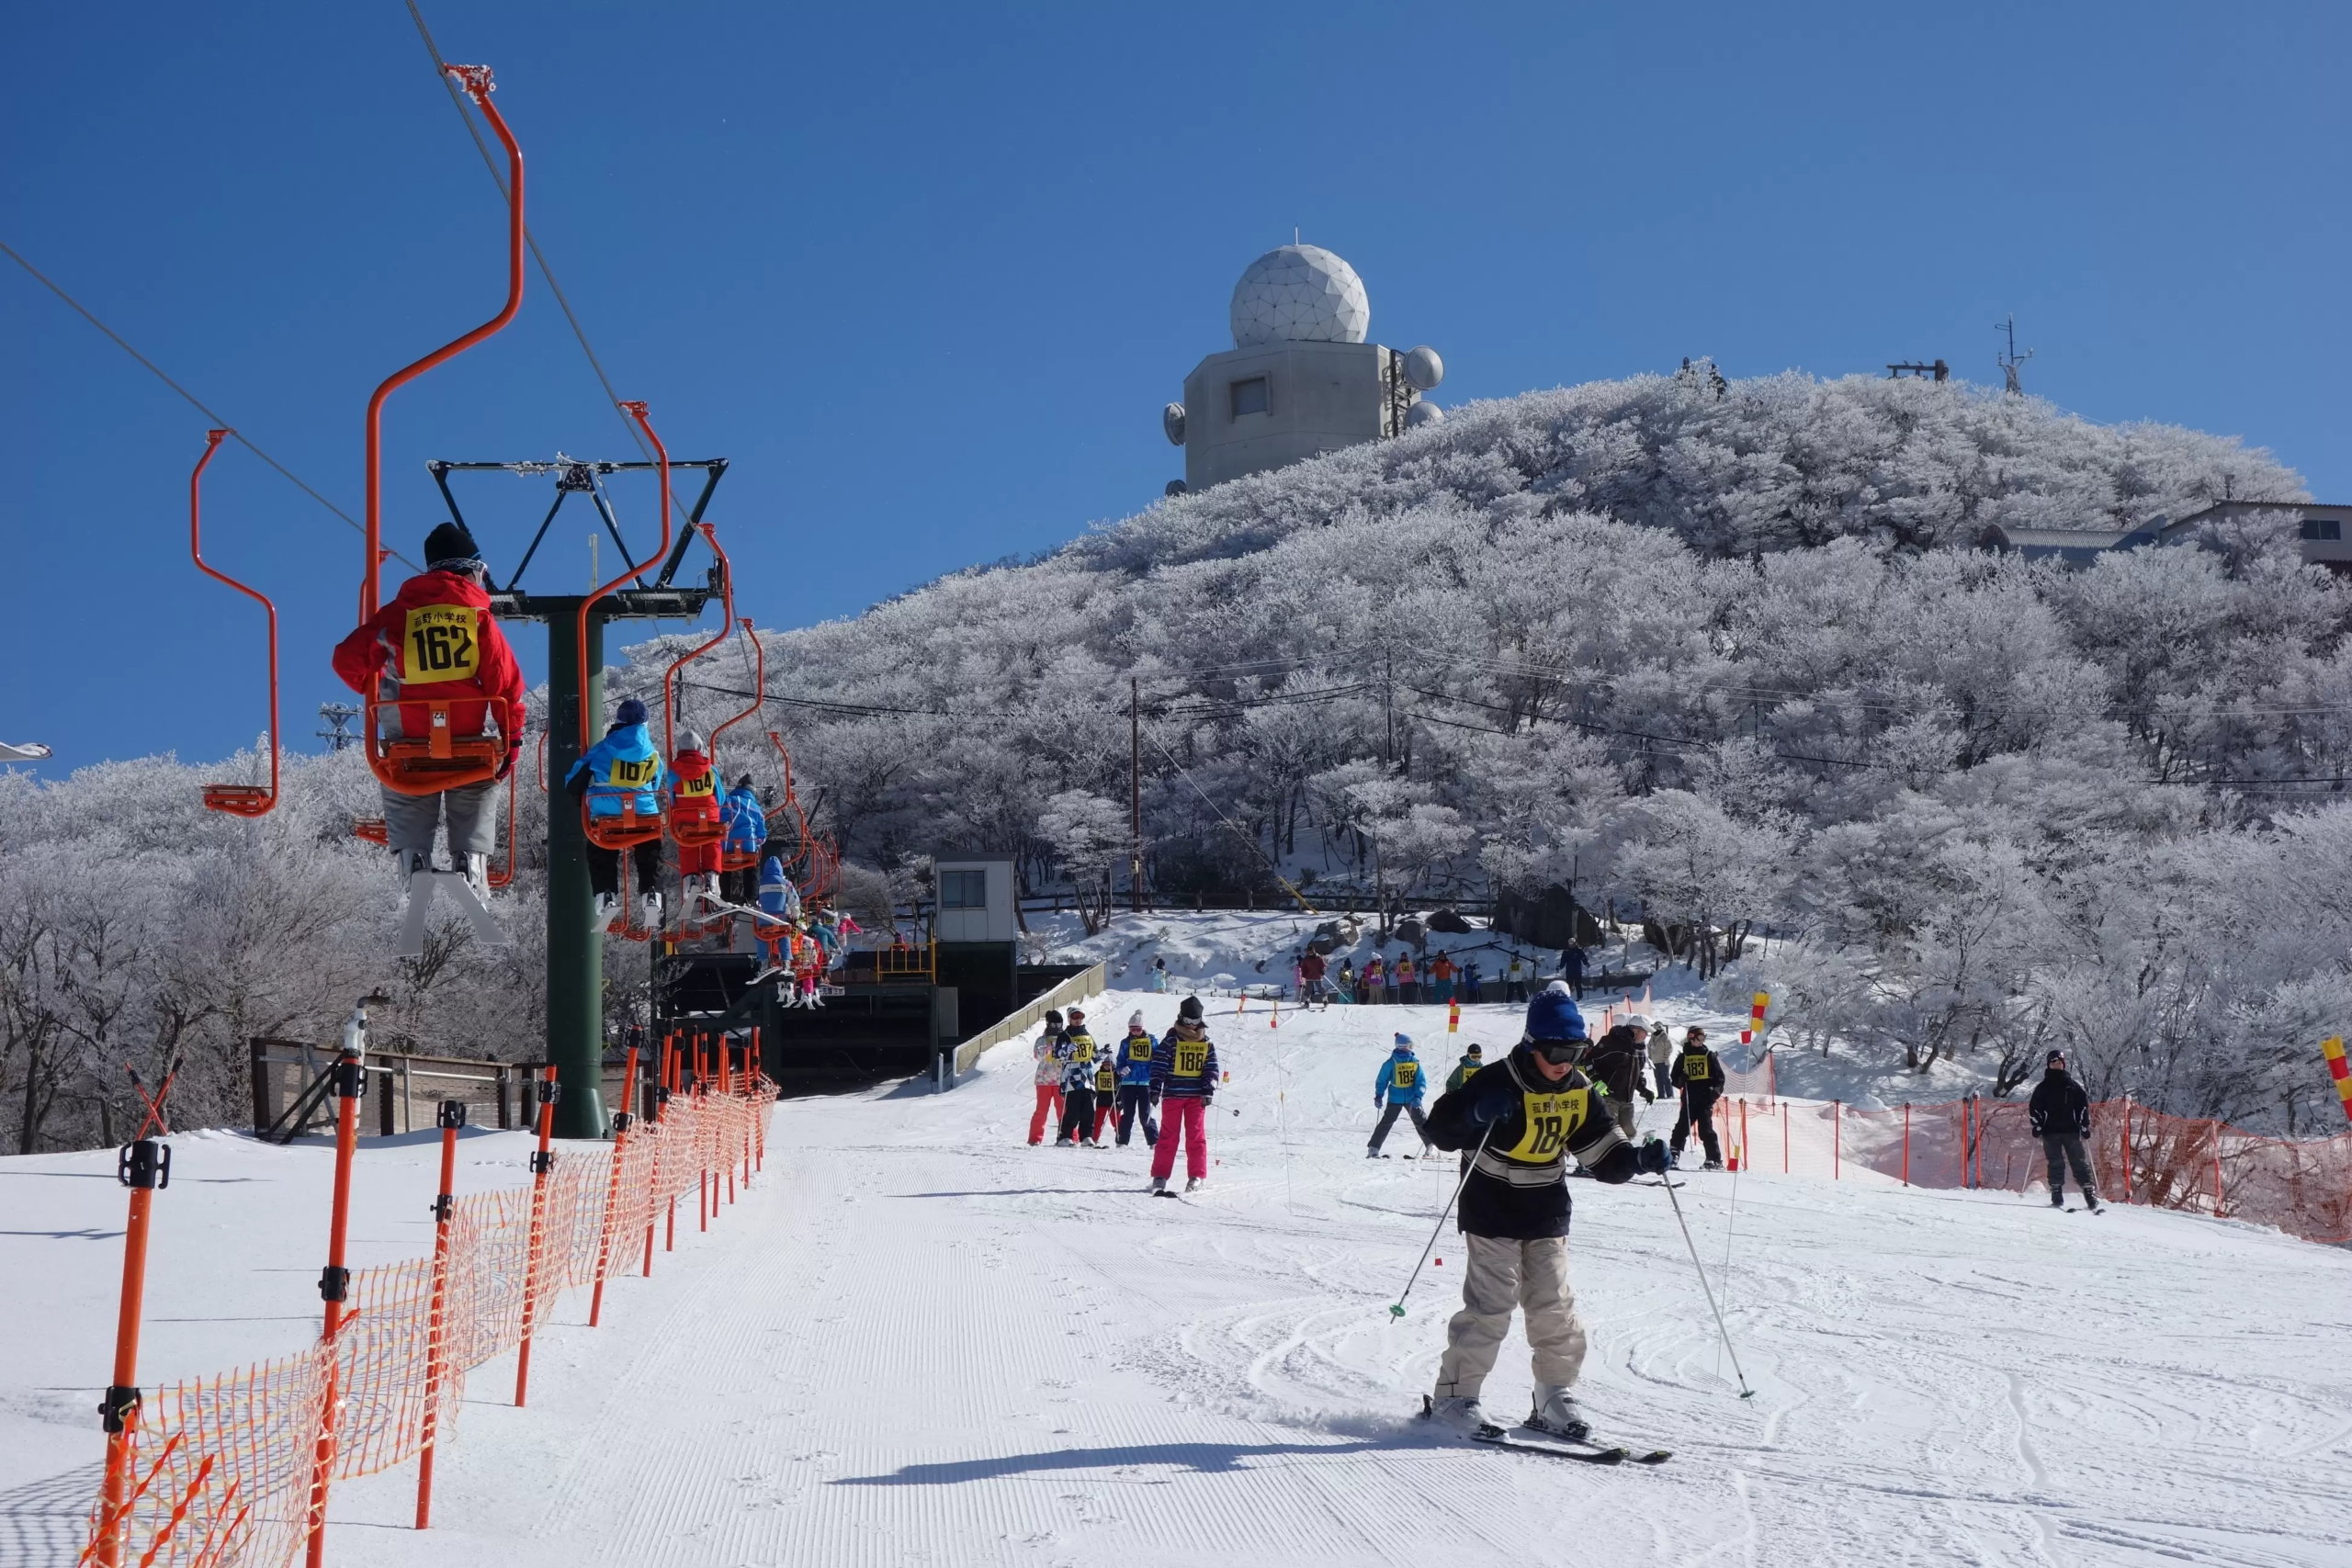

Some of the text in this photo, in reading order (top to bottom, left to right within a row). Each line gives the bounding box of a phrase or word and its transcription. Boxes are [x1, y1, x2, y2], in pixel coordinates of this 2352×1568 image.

[412, 625, 472, 671] 162
[619, 760, 654, 782] 167
[1077, 1043, 1091, 1058] 187
[1133, 1044, 1149, 1058] 190
[1180, 1052, 1204, 1071] 188
[1687, 1062, 1704, 1077] 183
[1100, 1078, 1112, 1089] 186
[1532, 1099, 1579, 1113] 菰野小学校
